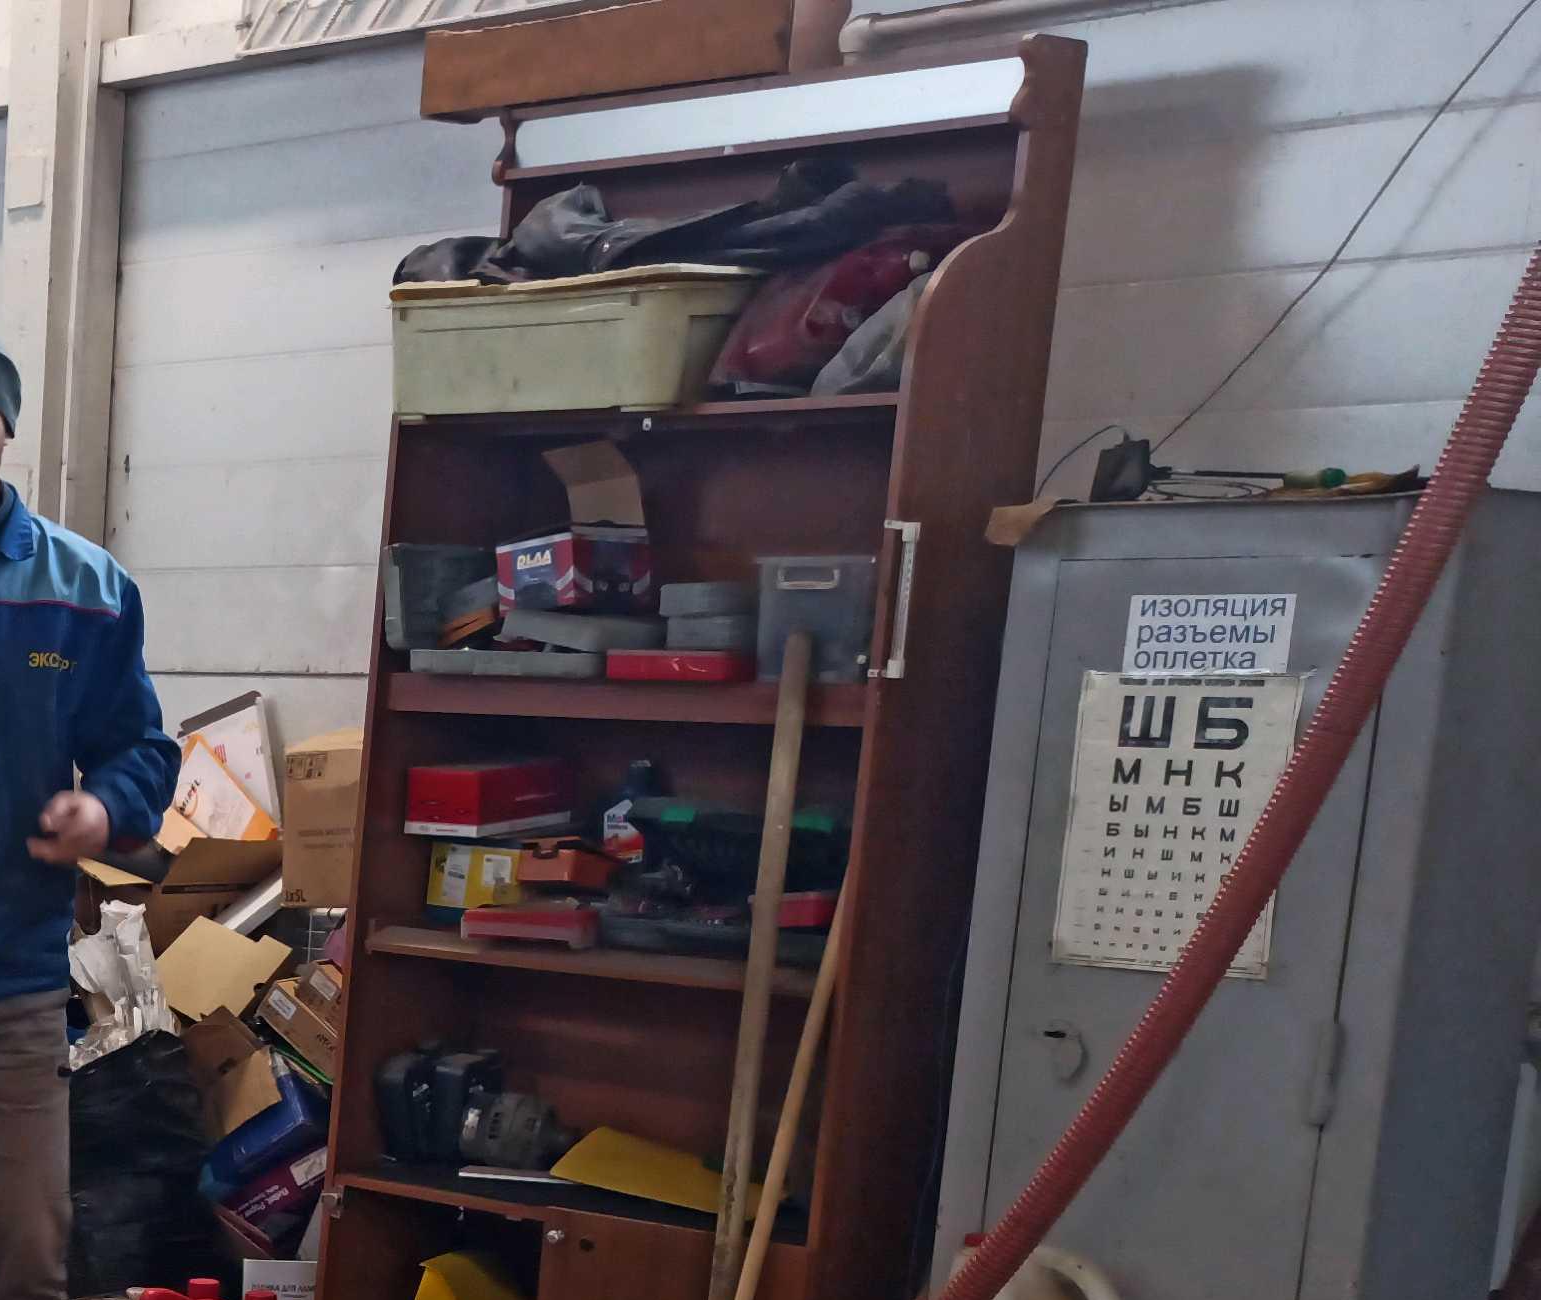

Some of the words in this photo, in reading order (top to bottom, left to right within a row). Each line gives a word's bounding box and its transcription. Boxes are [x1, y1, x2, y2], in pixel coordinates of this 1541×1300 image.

[1140, 598, 1287, 621] изоляция
[1137, 624, 1276, 649] разъемы
[1134, 650, 1257, 670] оплетка
[1117, 696, 1176, 748] Ш
[1194, 697, 1253, 750] Б
[1113, 758, 1142, 785] М
[1164, 760, 1193, 786] Н
[1215, 761, 1245, 788] К
[1109, 795, 1129, 813] Ы
[1146, 796, 1166, 814] М
[1182, 798, 1202, 816] Б
[1219, 799, 1240, 818] Ш
[1106, 823, 1121, 837] Б
[1134, 824, 1149, 839] Ы
[1163, 825, 1178, 840] Н
[1191, 826, 1206, 841] К
[1220, 828, 1236, 843] М
